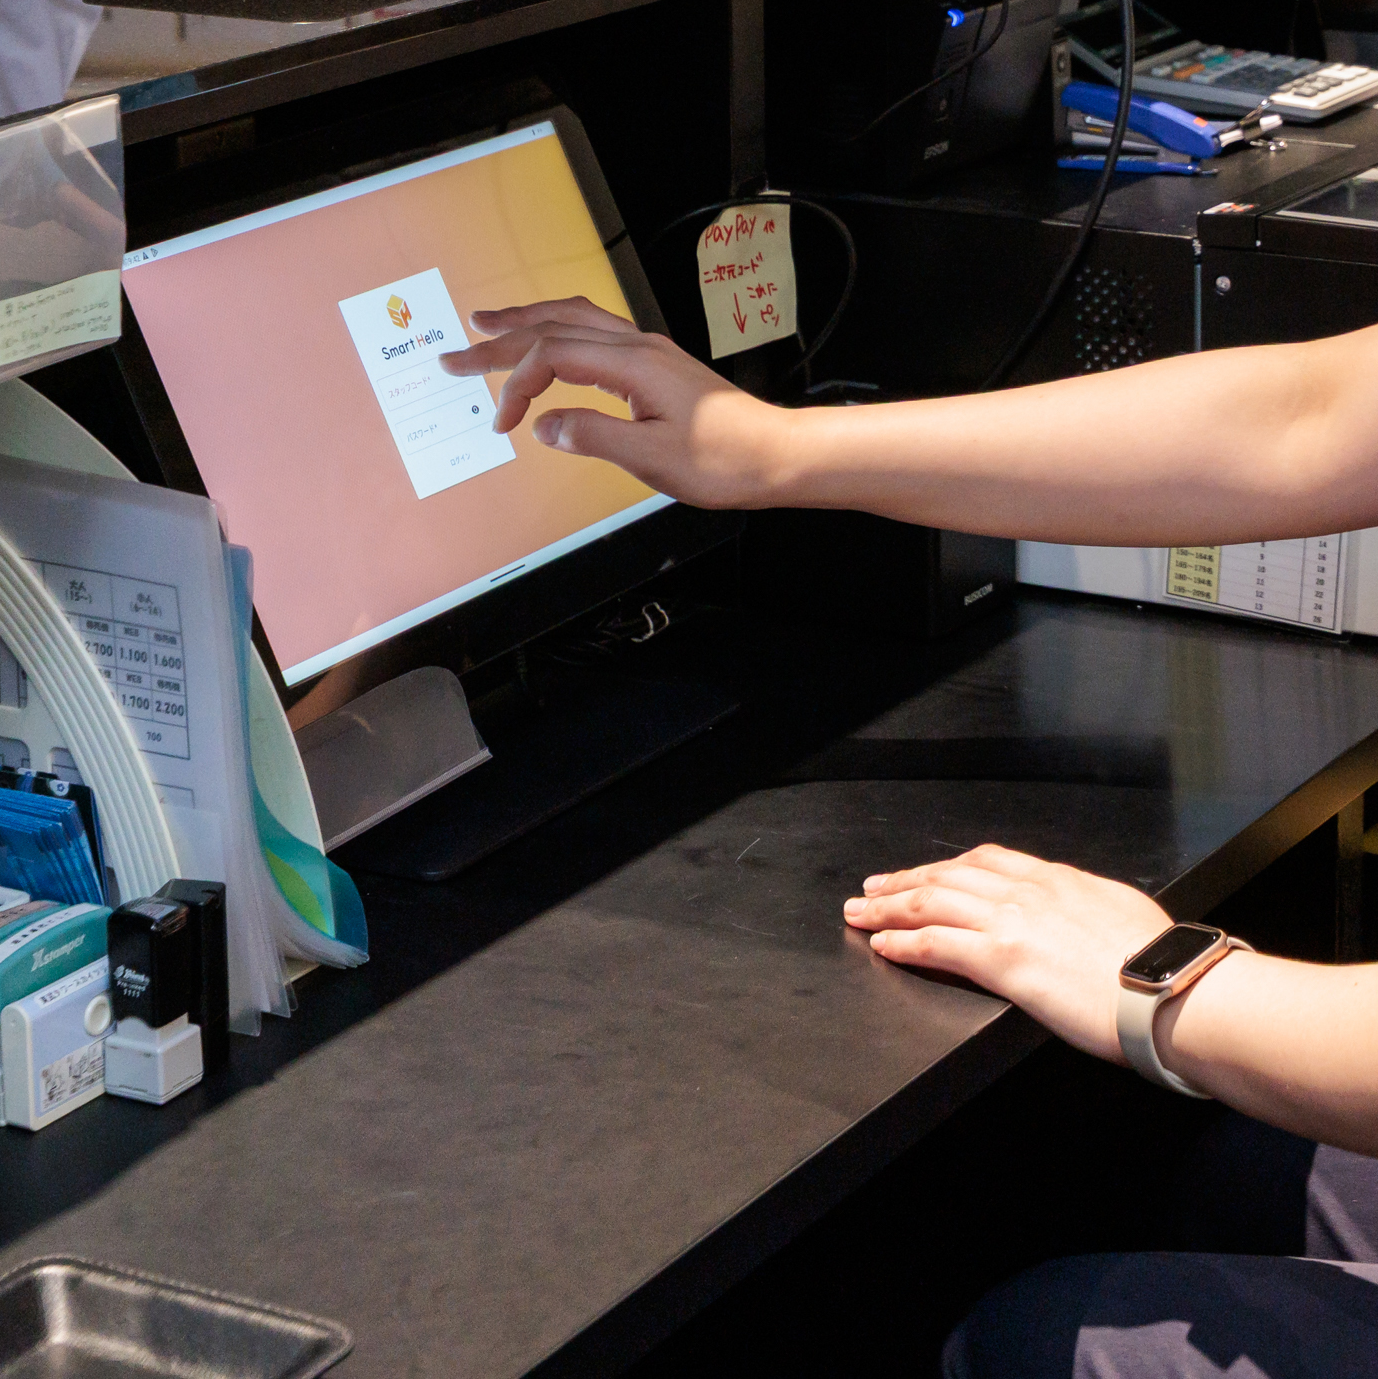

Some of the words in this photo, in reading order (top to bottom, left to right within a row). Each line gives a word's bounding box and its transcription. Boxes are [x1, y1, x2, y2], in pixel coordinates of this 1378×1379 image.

[705, 213, 757, 249] PayPay
[703, 251, 764, 284] 二次元コード
[381, 337, 416, 361] Smart
[415, 327, 445, 348] Hello
[450, 451, 471, 467] ログイン
[146, 731, 162, 743] 700
